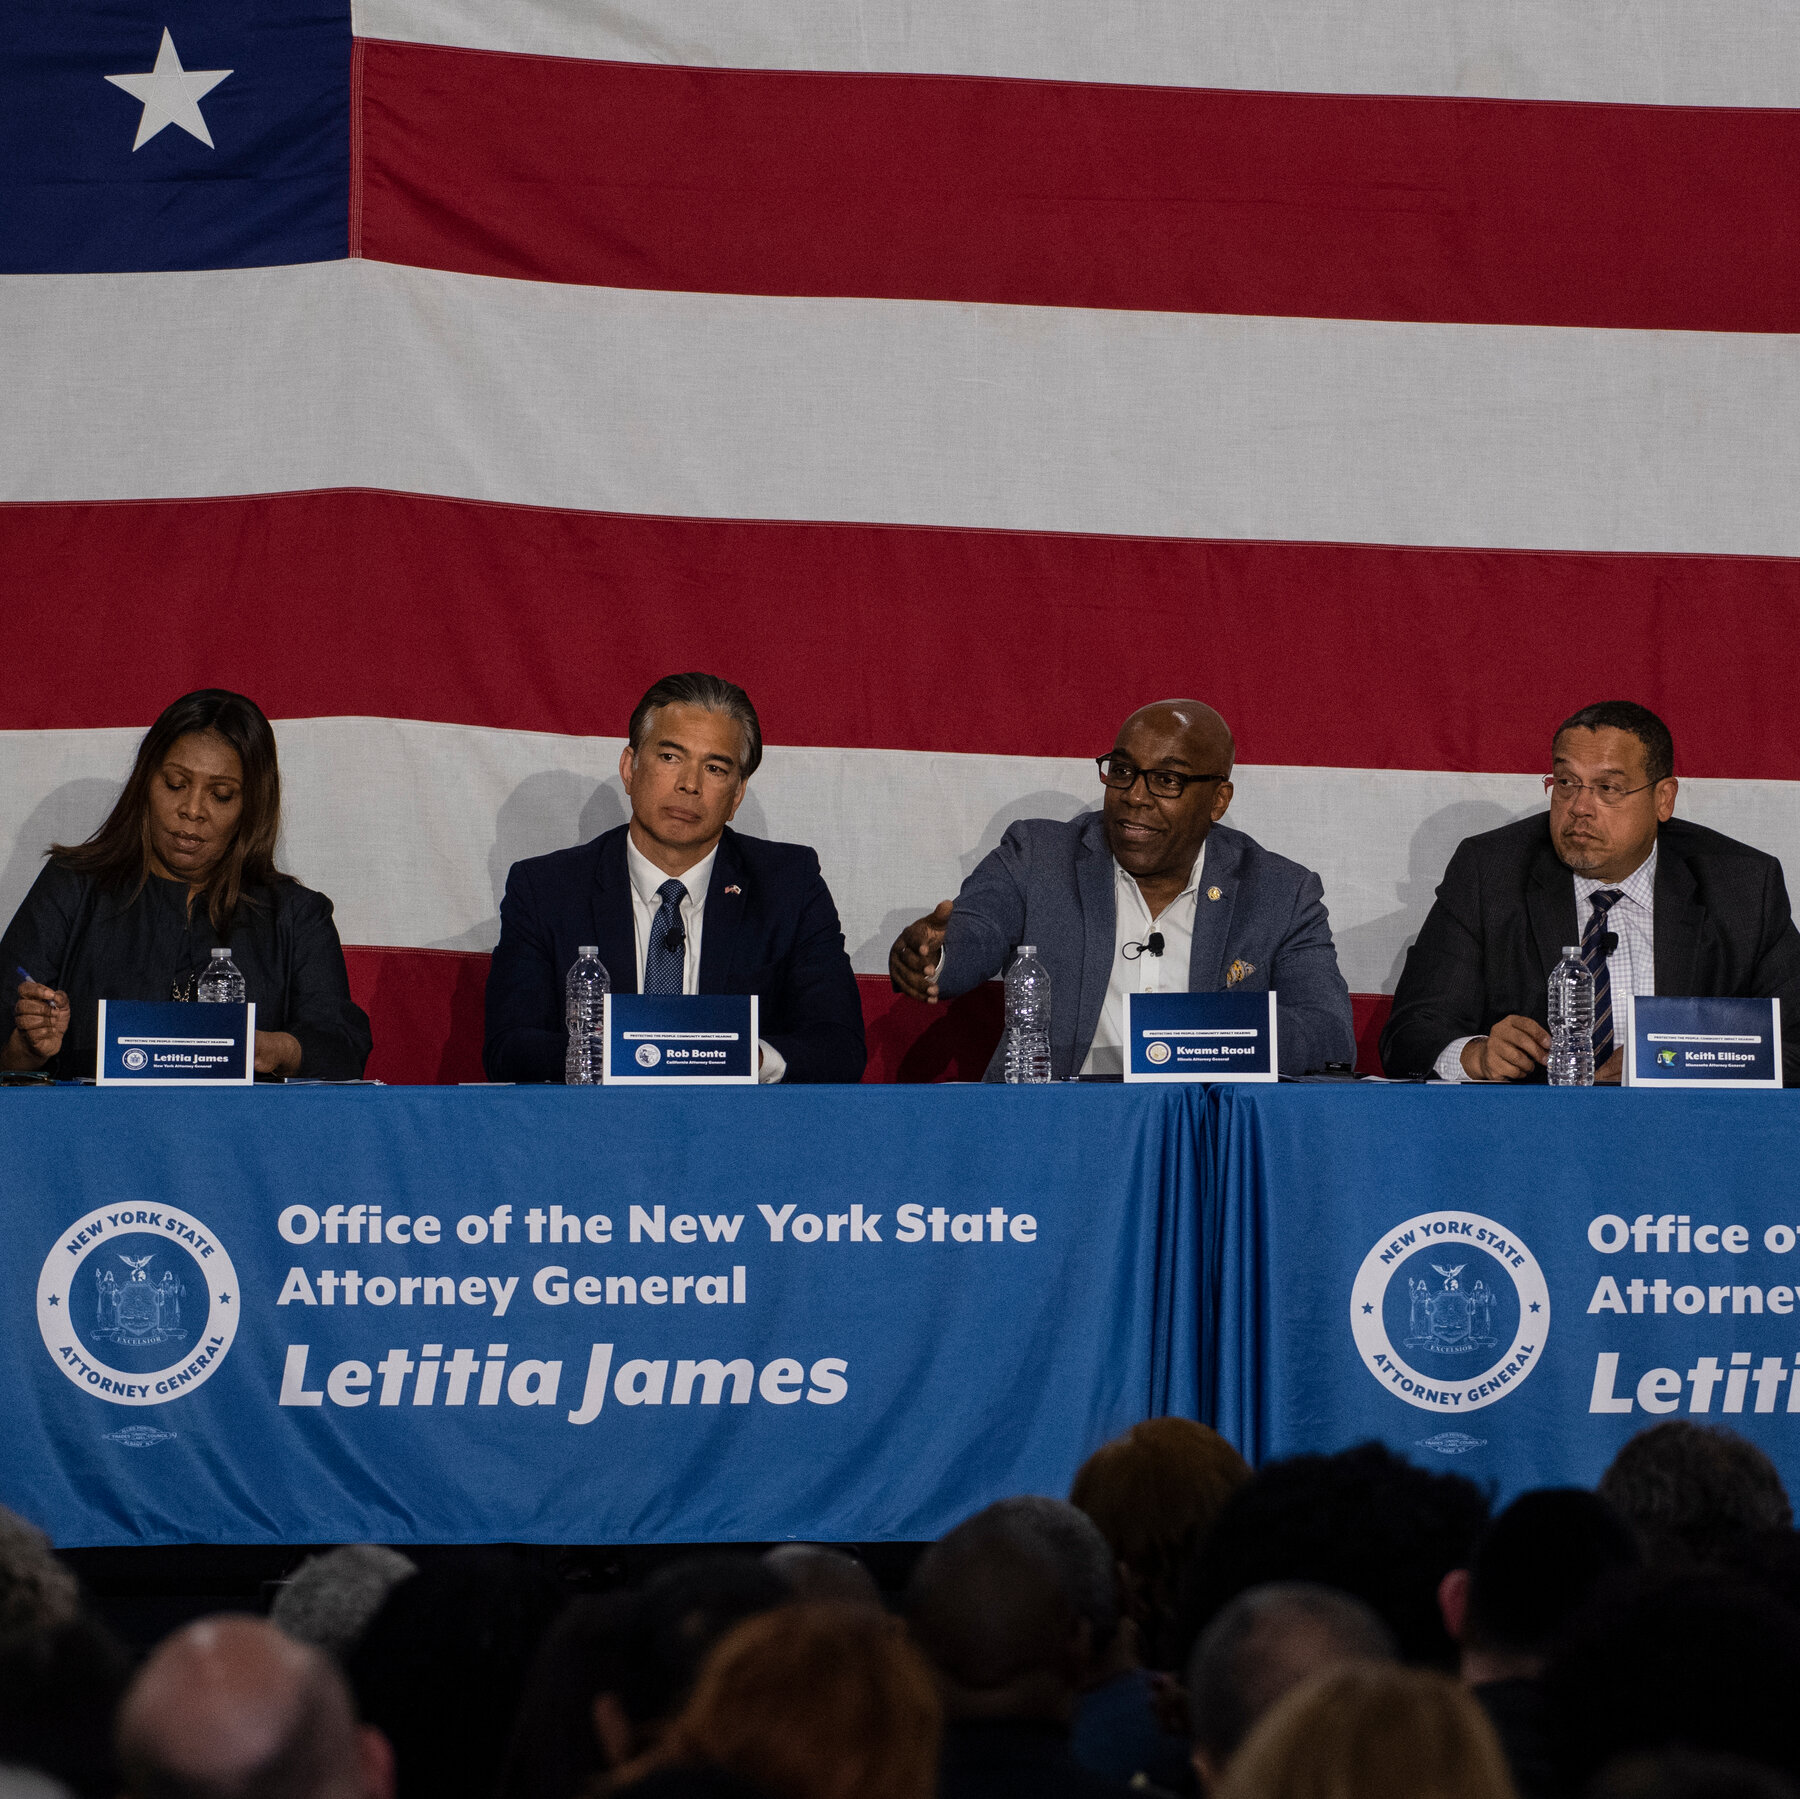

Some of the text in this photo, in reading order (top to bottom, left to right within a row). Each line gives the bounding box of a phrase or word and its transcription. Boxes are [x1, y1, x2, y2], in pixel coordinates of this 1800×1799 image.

[154, 1053, 192, 1062] Letitia
[192, 1054, 229, 1064] James
[666, 1049, 726, 1058] Rob Bonta
[1176, 1046, 1255, 1055] Kwame Raoul
[1685, 1052, 1755, 1061] Keith Ellison
[66, 1211, 215, 1259] NEW YORK STATE
[278, 1203, 1037, 1244] Office of the New York State
[1587, 1214, 1800, 1254] Office o
[1379, 1221, 1525, 1268] NEW YORK STATE
[276, 1265, 746, 1316] Attorney General
[1586, 1276, 1800, 1314] Attorne
[117, 1336, 161, 1345] EXCELSIOR
[59, 1334, 225, 1398] ATTORNEY GENERAL
[279, 1343, 849, 1425] Letitia James
[1373, 1343, 1535, 1405] ATTORNEY GENERAL
